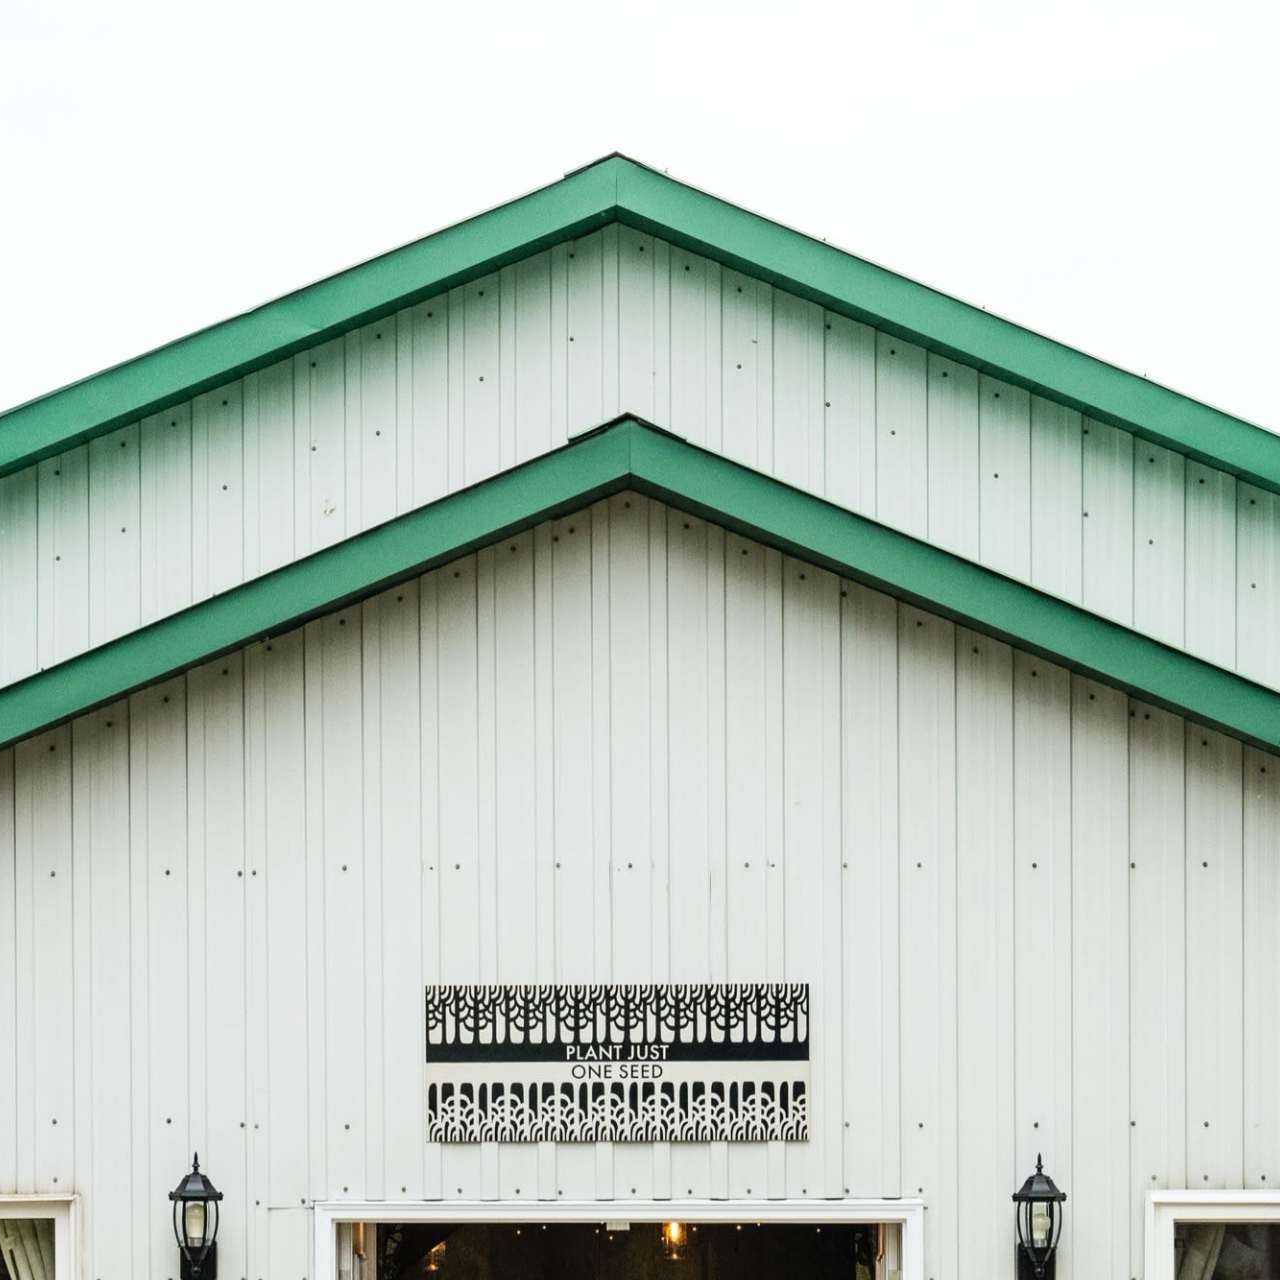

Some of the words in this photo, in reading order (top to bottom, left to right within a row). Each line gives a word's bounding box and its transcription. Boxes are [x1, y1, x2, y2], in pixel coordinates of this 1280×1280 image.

[566, 1045, 623, 1060] PLANT
[627, 1045, 669, 1060] JUST
[572, 1064, 612, 1079] ONE
[619, 1064, 663, 1079] SEED
